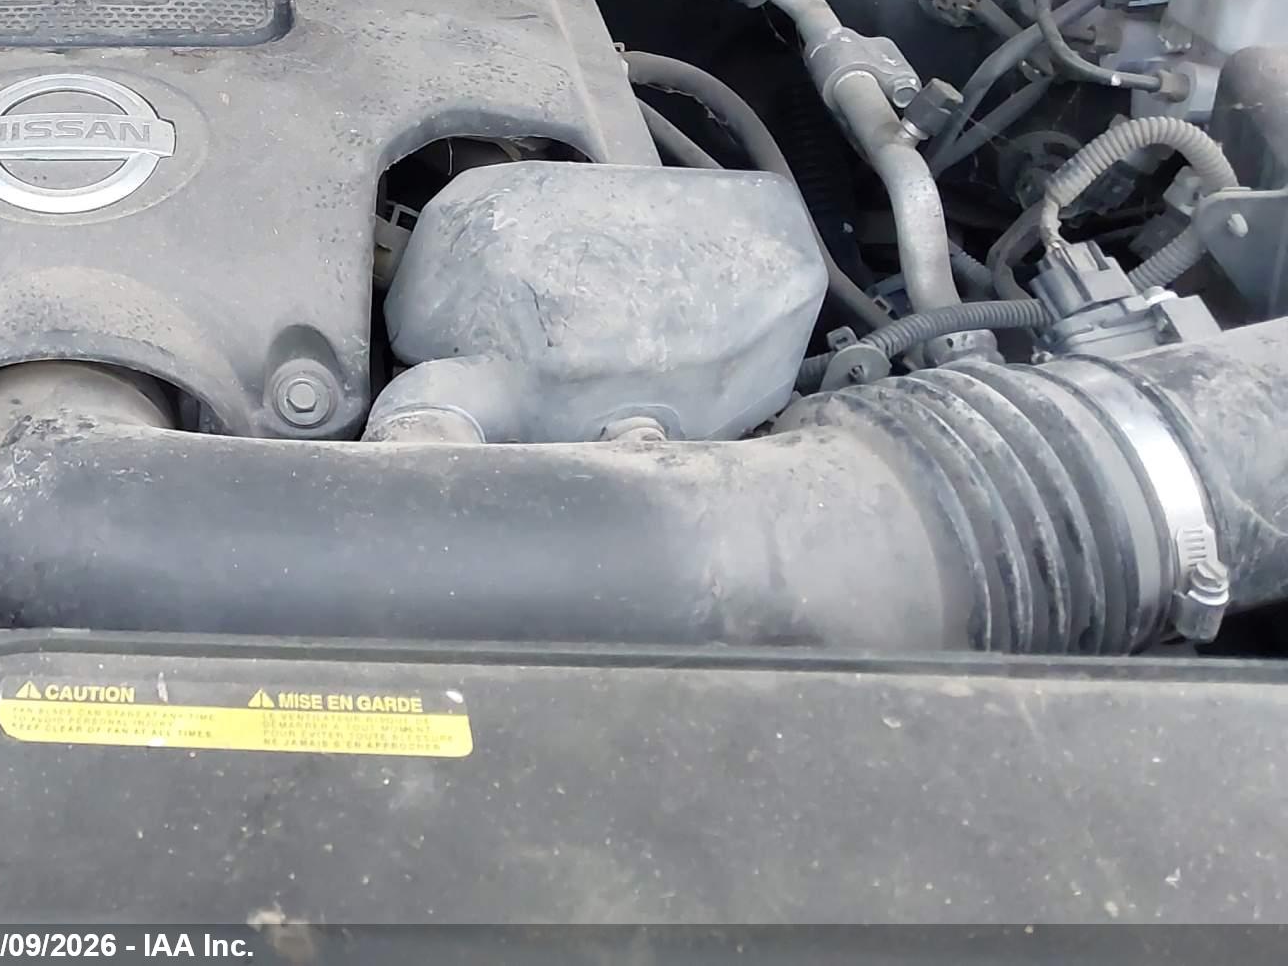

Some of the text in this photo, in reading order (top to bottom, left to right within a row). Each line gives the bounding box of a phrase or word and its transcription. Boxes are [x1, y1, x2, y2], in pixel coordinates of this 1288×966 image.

[45, 684, 136, 704] CAUTION
[278, 692, 423, 713] MISE EN GARDE
